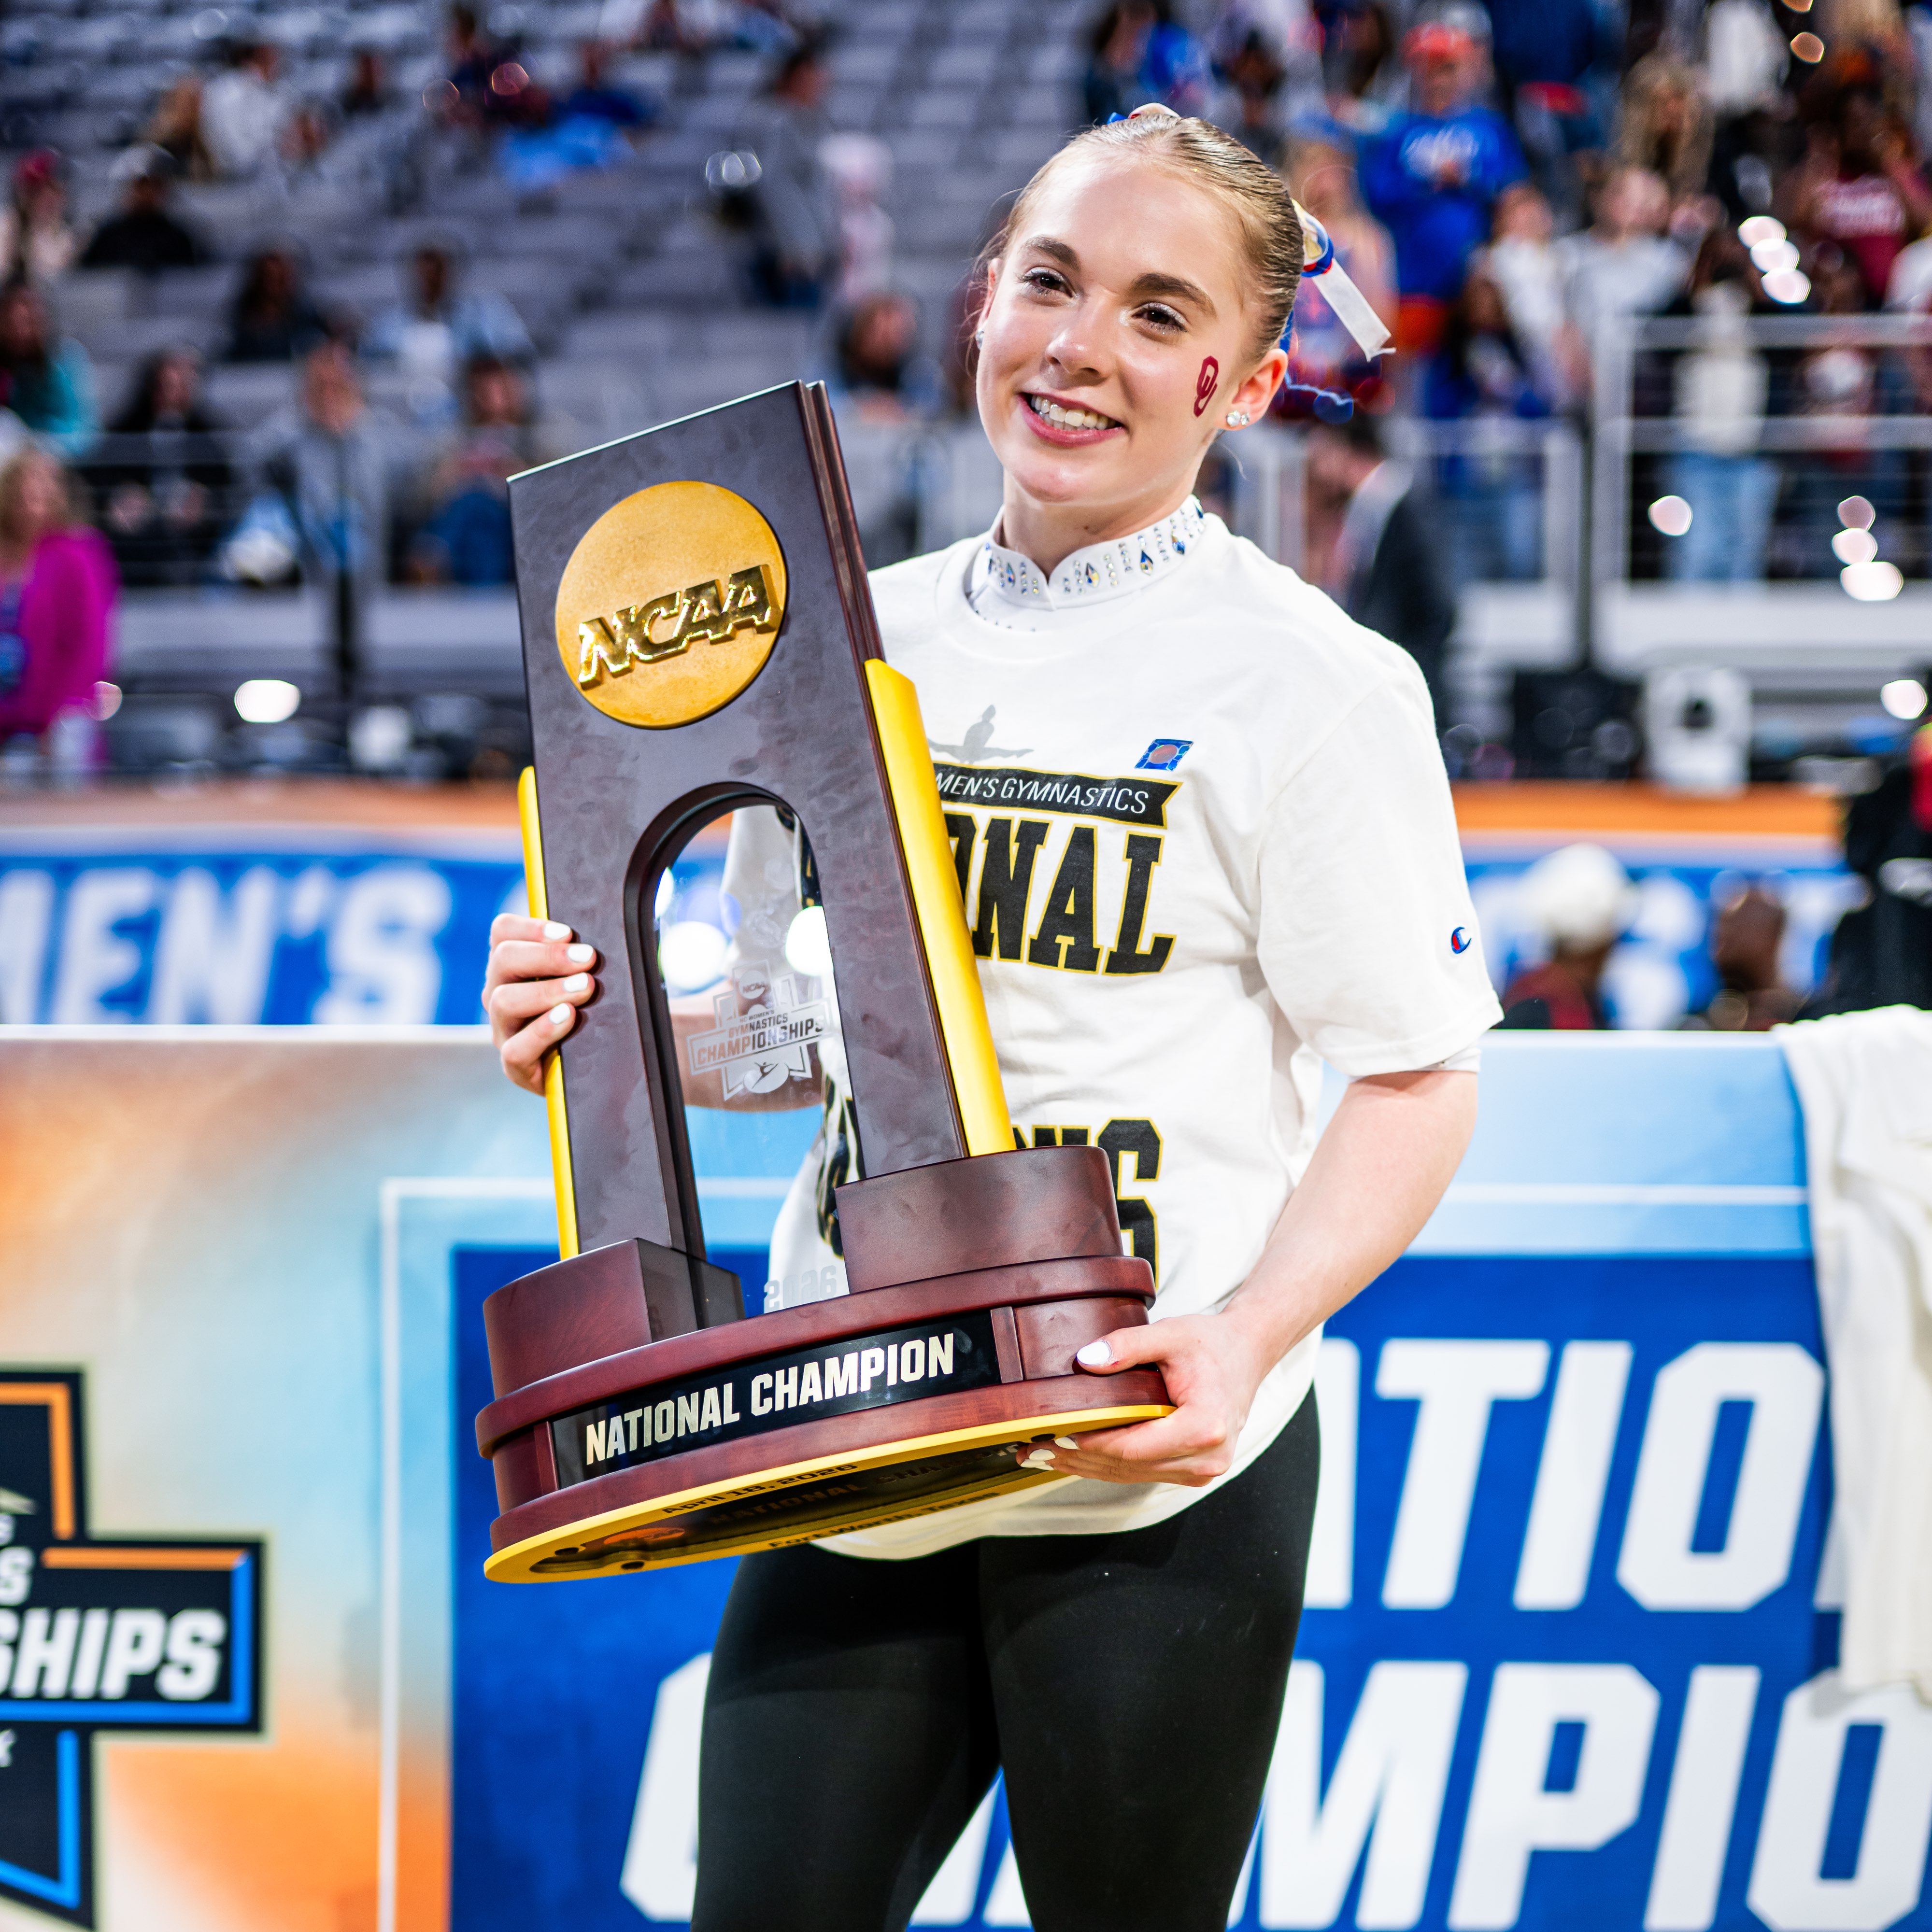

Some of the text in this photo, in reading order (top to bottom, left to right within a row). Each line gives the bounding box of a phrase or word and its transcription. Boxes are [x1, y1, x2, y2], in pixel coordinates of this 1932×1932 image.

[578, 564, 779, 689] NCAA
[1001, 777, 1149, 814] GYMNASTICS
[728, 1013, 788, 1038] GYMNASTICS
[748, 1009, 775, 1020] WOMEN'S
[697, 1016, 824, 1065] CHAMPIONSHIPS
[764, 1265, 837, 1314] 2026
[586, 1333, 954, 1465] NATIONAL CHAMPION
[662, 1496, 727, 1514] April
[777, 1464, 858, 1485] 2026
[1303, 1339, 1844, 1613] TIO
[768, 1533, 824, 1548] Fort
[924, 1492, 1000, 1511] Texas
